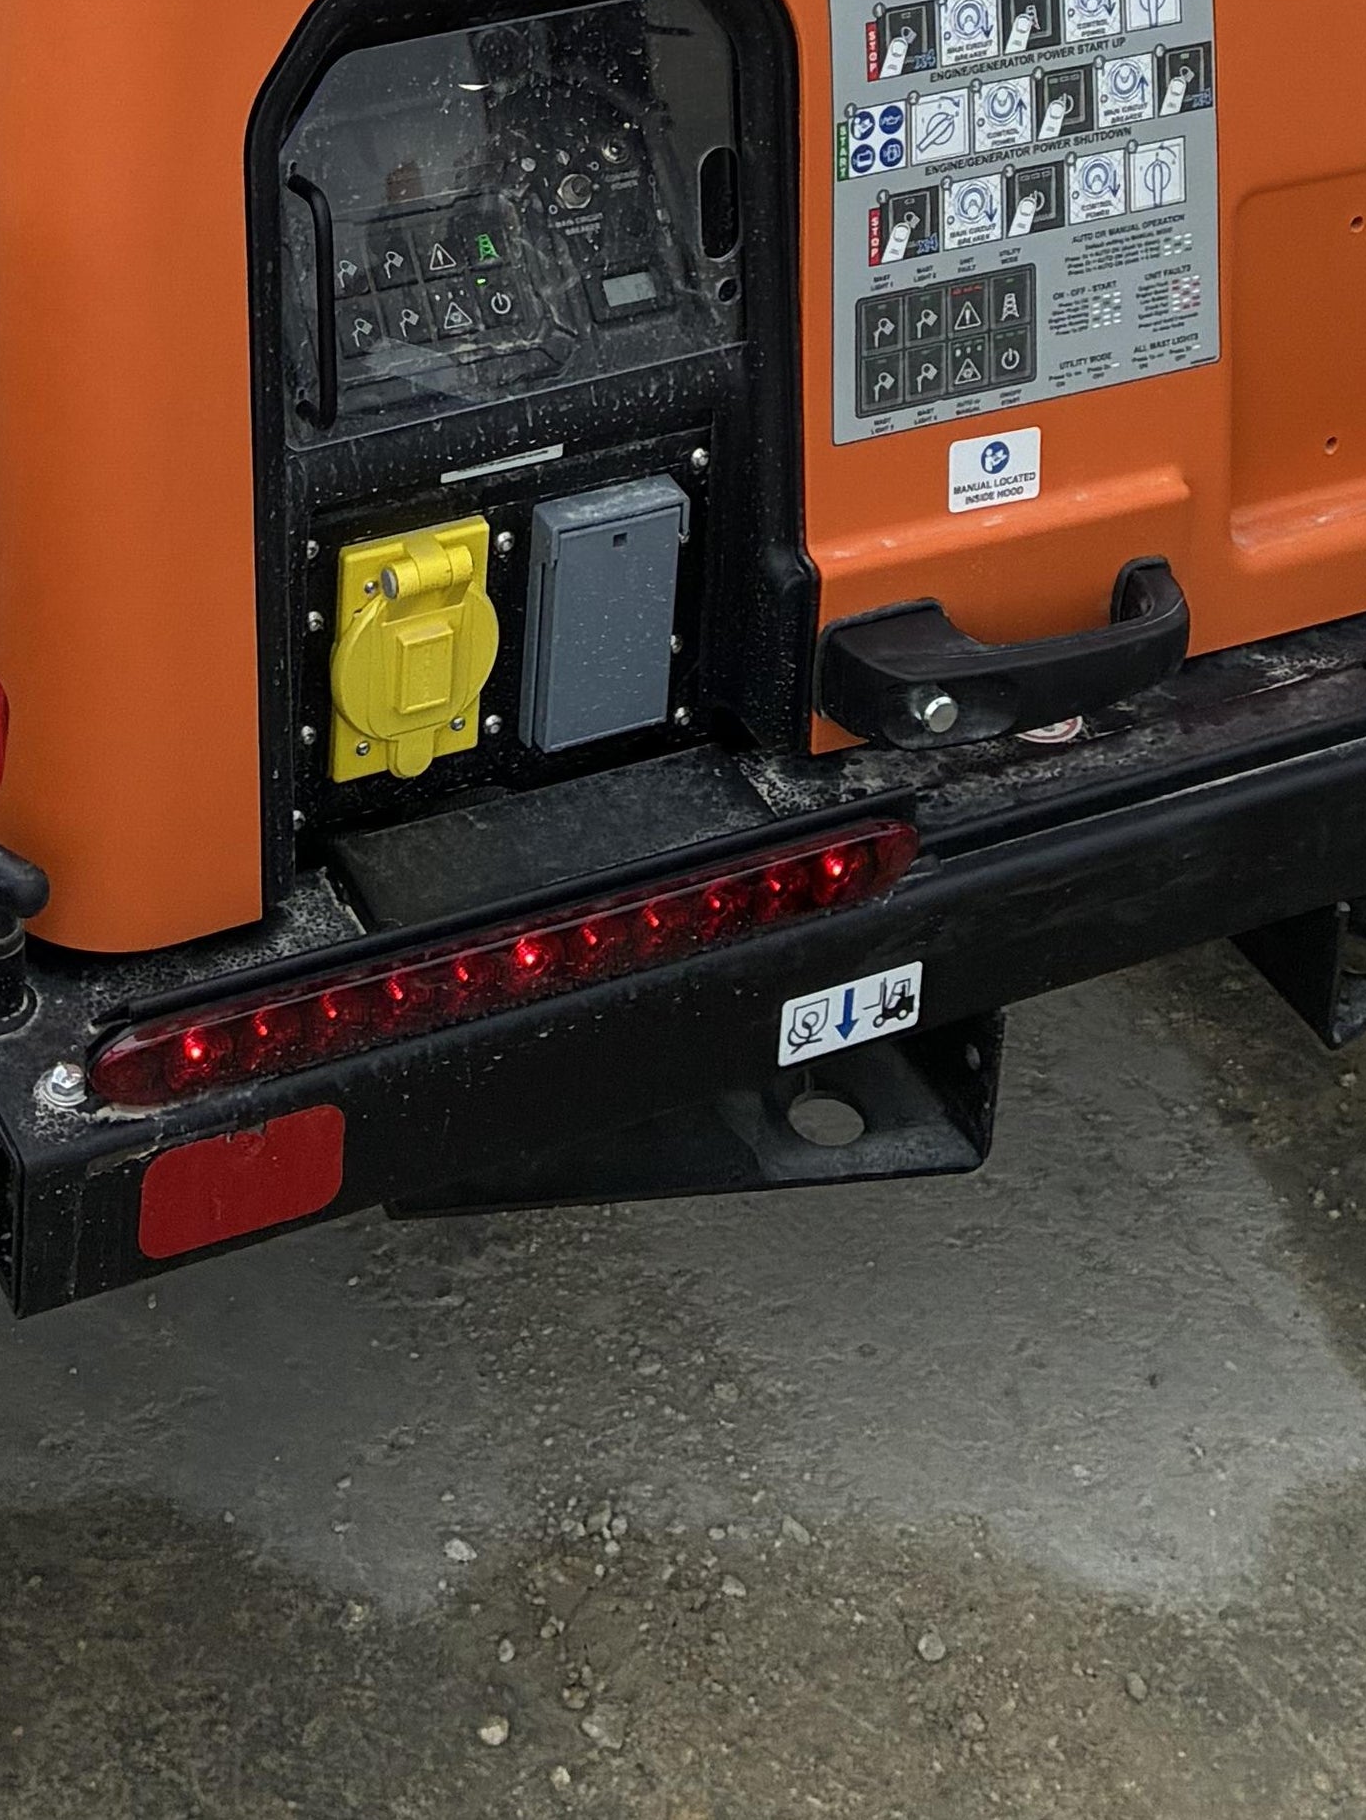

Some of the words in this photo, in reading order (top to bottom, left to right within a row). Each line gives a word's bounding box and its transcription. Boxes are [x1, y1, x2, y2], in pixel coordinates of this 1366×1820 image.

[1036, 45, 1074, 62] POWER
[1076, 39, 1108, 55] START
[1111, 35, 1126, 48] UP
[1032, 137, 1070, 155] POWER
[1072, 125, 1131, 147] SHUTDOWN
[954, 480, 993, 496] MANUAL
[994, 471, 1036, 489] LOCATED
[965, 490, 995, 506] INSIDE
[997, 485, 1024, 500] HOOD
